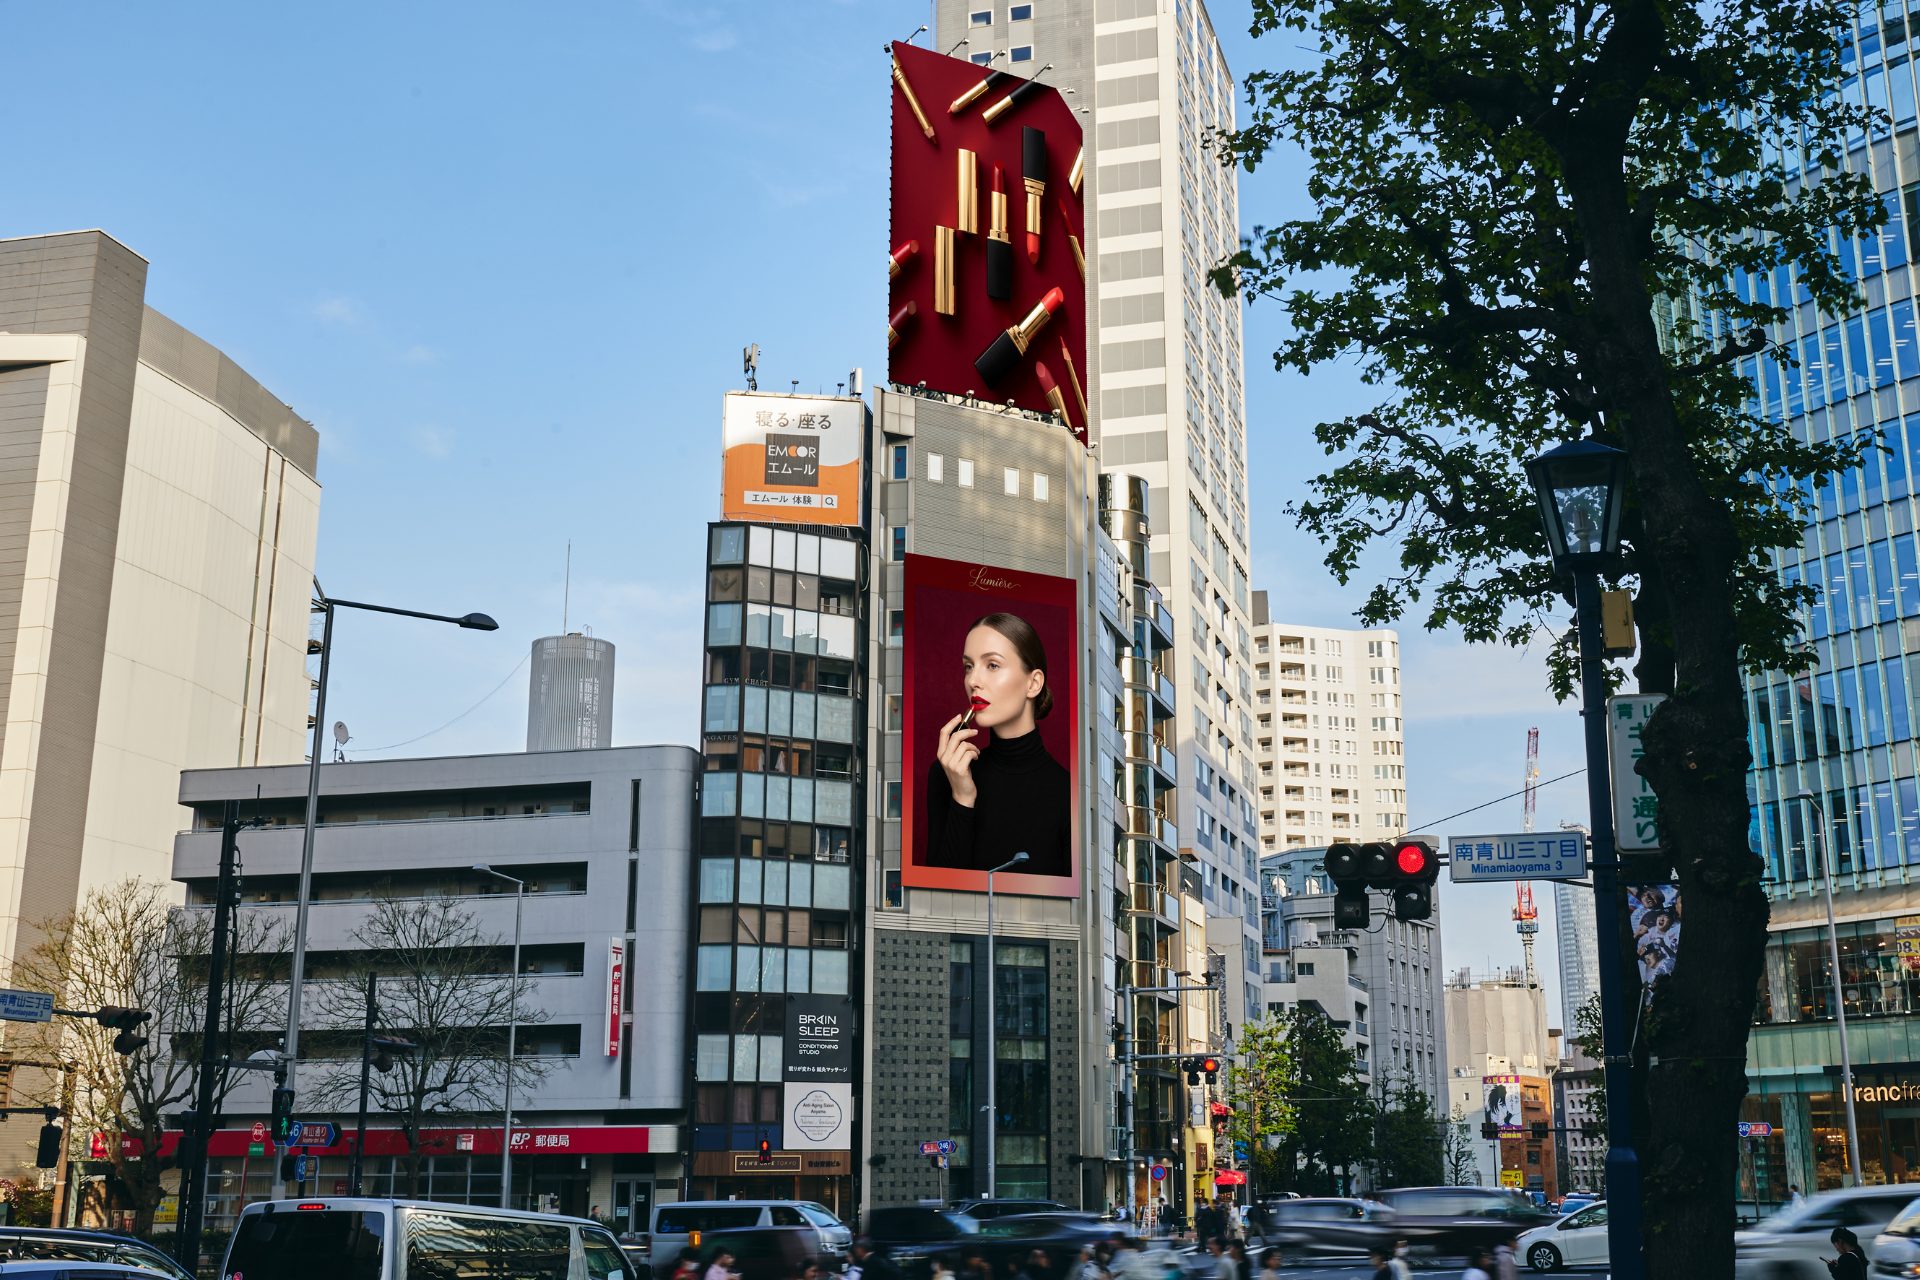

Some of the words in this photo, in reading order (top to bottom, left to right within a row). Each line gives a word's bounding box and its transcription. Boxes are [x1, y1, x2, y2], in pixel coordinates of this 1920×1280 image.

[767, 462, 816, 475] エムール
[751, 494, 789, 503] エムール
[792, 495, 812, 505] 体験
[968, 566, 1021, 591] Lumière
[1454, 839, 1578, 862] 南青山三丁目
[1471, 863, 1551, 874] Minamiaoyama
[1555, 860, 1563, 871] 3
[798, 1014, 837, 1025] BRAIN
[798, 1026, 840, 1037] SLEEP
[535, 1134, 570, 1147] 郵便局
